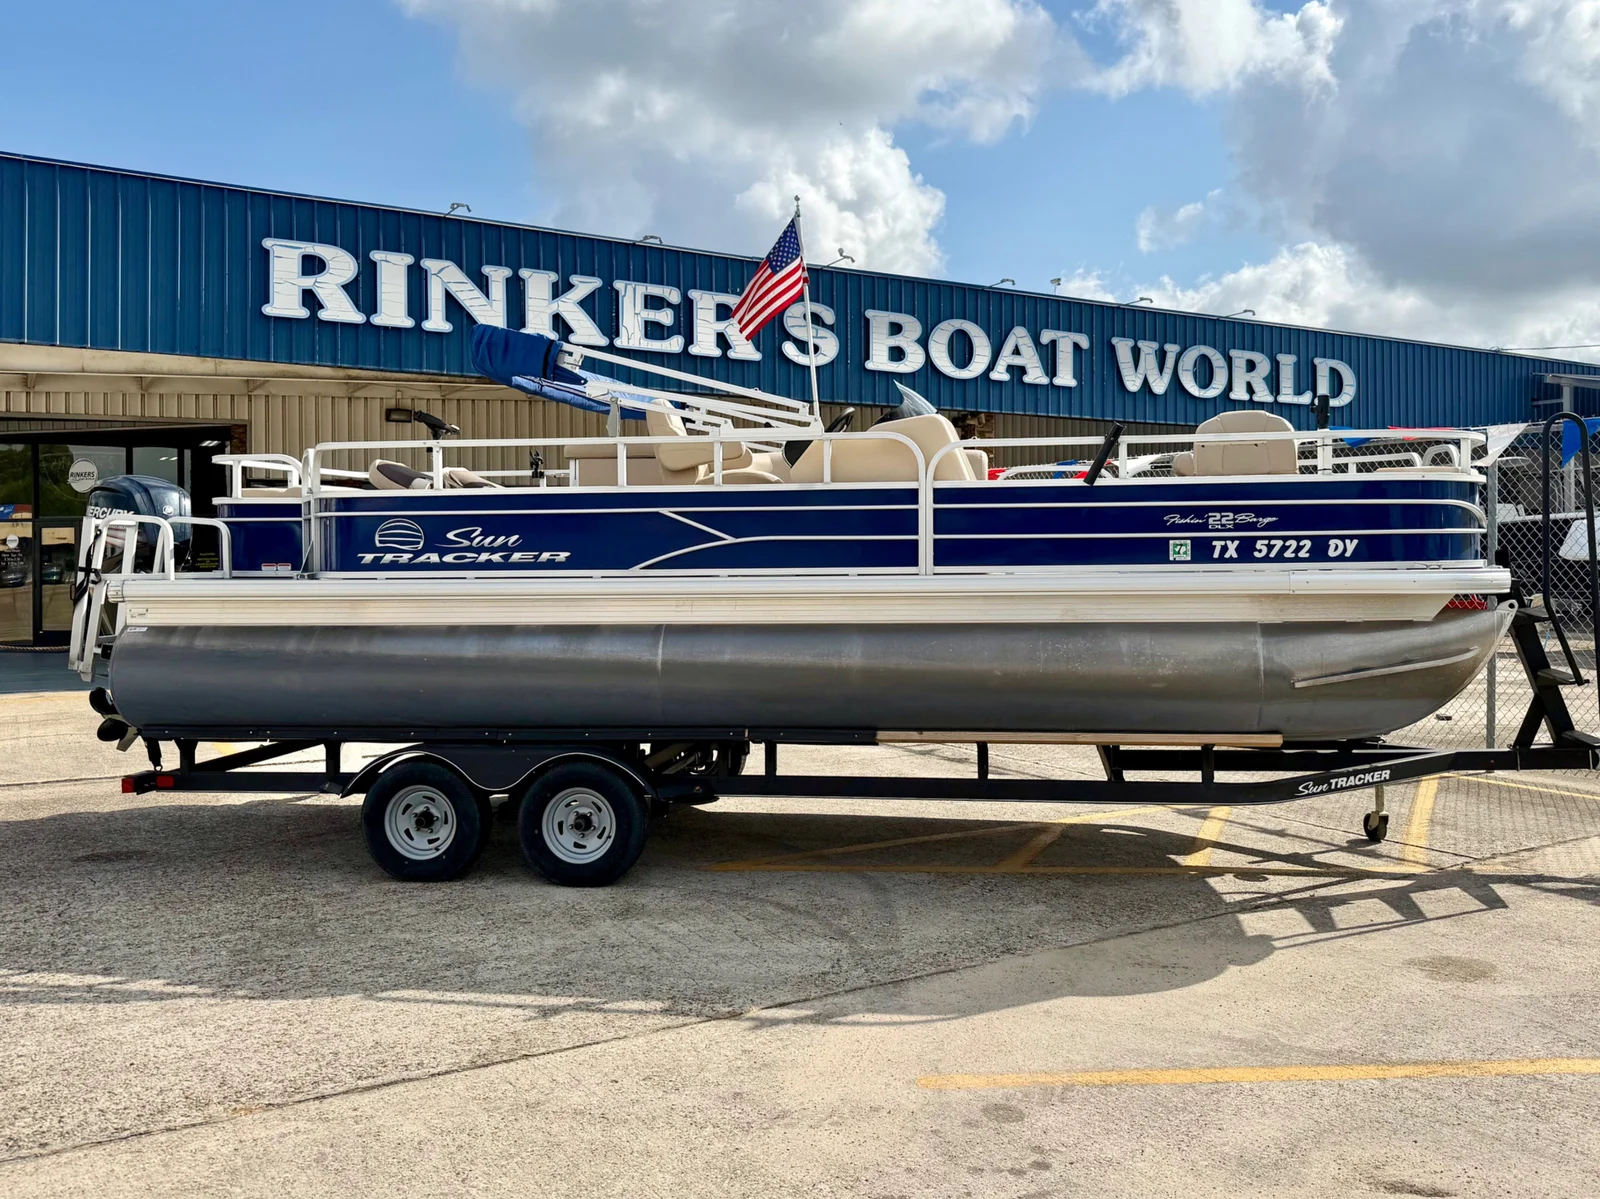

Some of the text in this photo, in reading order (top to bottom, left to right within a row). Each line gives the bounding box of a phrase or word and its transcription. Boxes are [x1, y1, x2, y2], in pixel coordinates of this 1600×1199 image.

[261, 237, 1357, 408] RINKERS BOAT WORLD
[1208, 512, 1234, 525] 22
[1234, 513, 1279, 528] Barge
[434, 526, 523, 548] Sun
[356, 551, 572, 564] TRACKER
[1212, 539, 1359, 559] TX 5722 DY
[1294, 769, 1391, 796] Sun TRACKER
